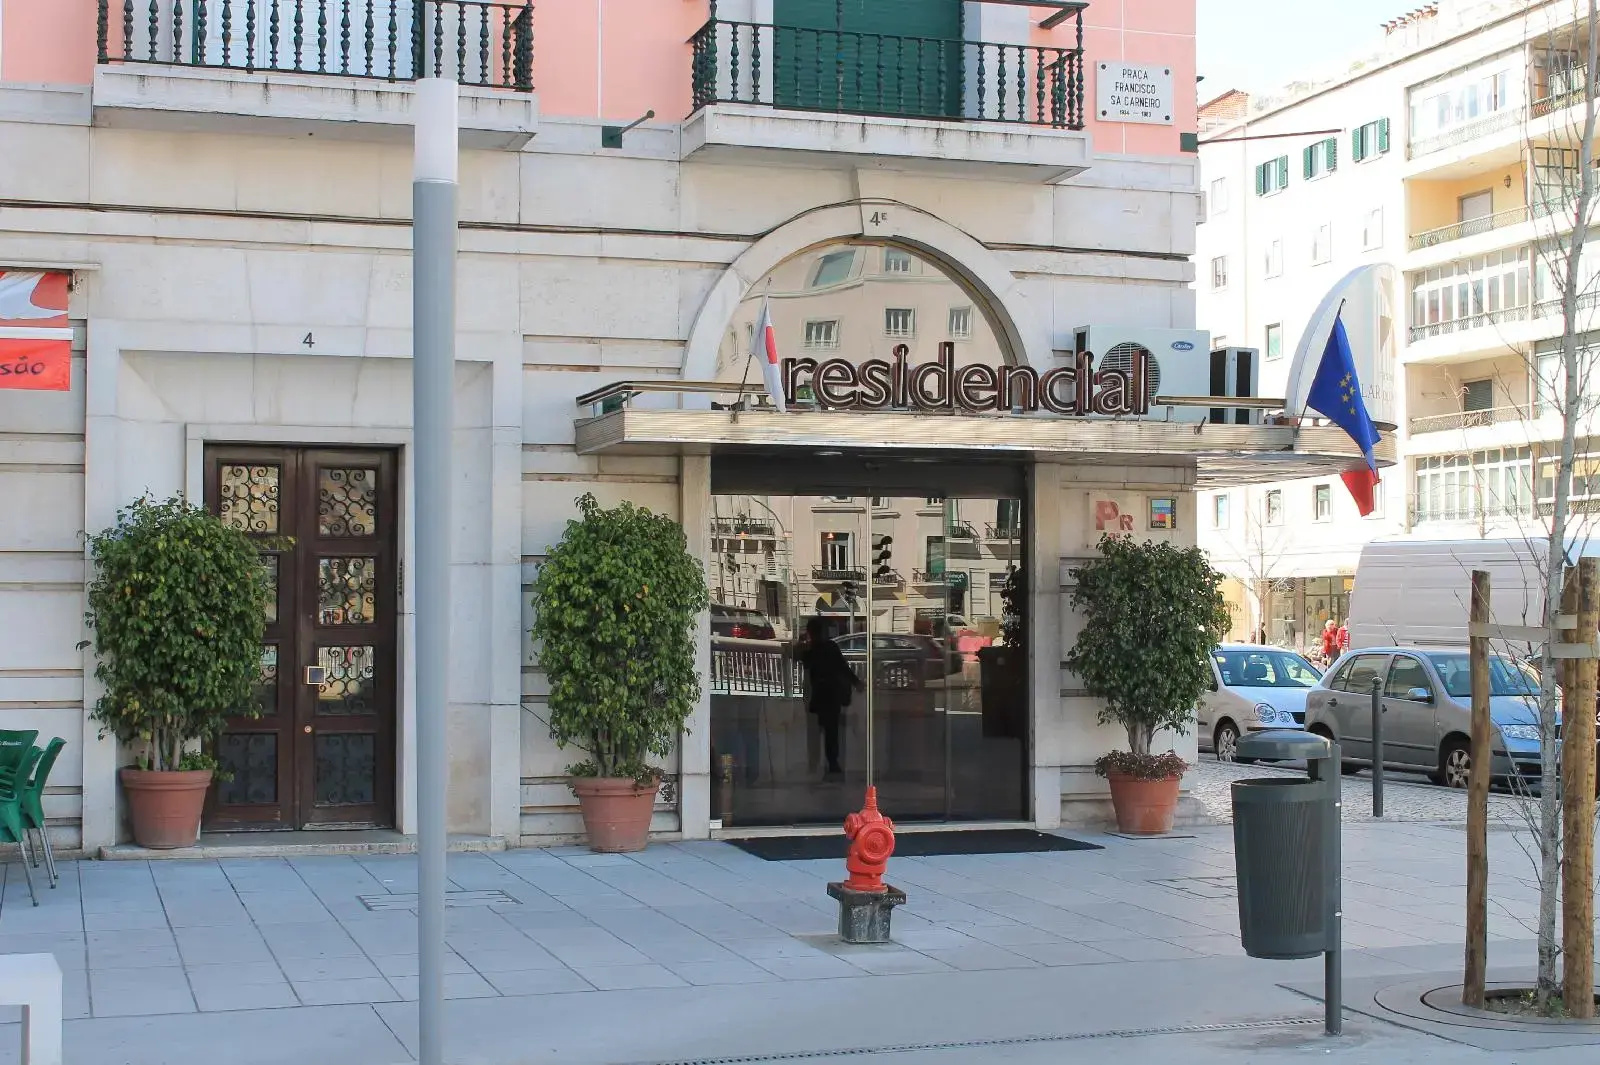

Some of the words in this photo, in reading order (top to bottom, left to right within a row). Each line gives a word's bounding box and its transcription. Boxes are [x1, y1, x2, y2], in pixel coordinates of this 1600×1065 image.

[1115, 82, 1155, 94] FRANCISCO
[1124, 97, 1161, 108] CARNEIRO
[302, 332, 315, 348] 4
[782, 341, 1149, 416] residencial
[1361, 383, 1380, 399] LAR
